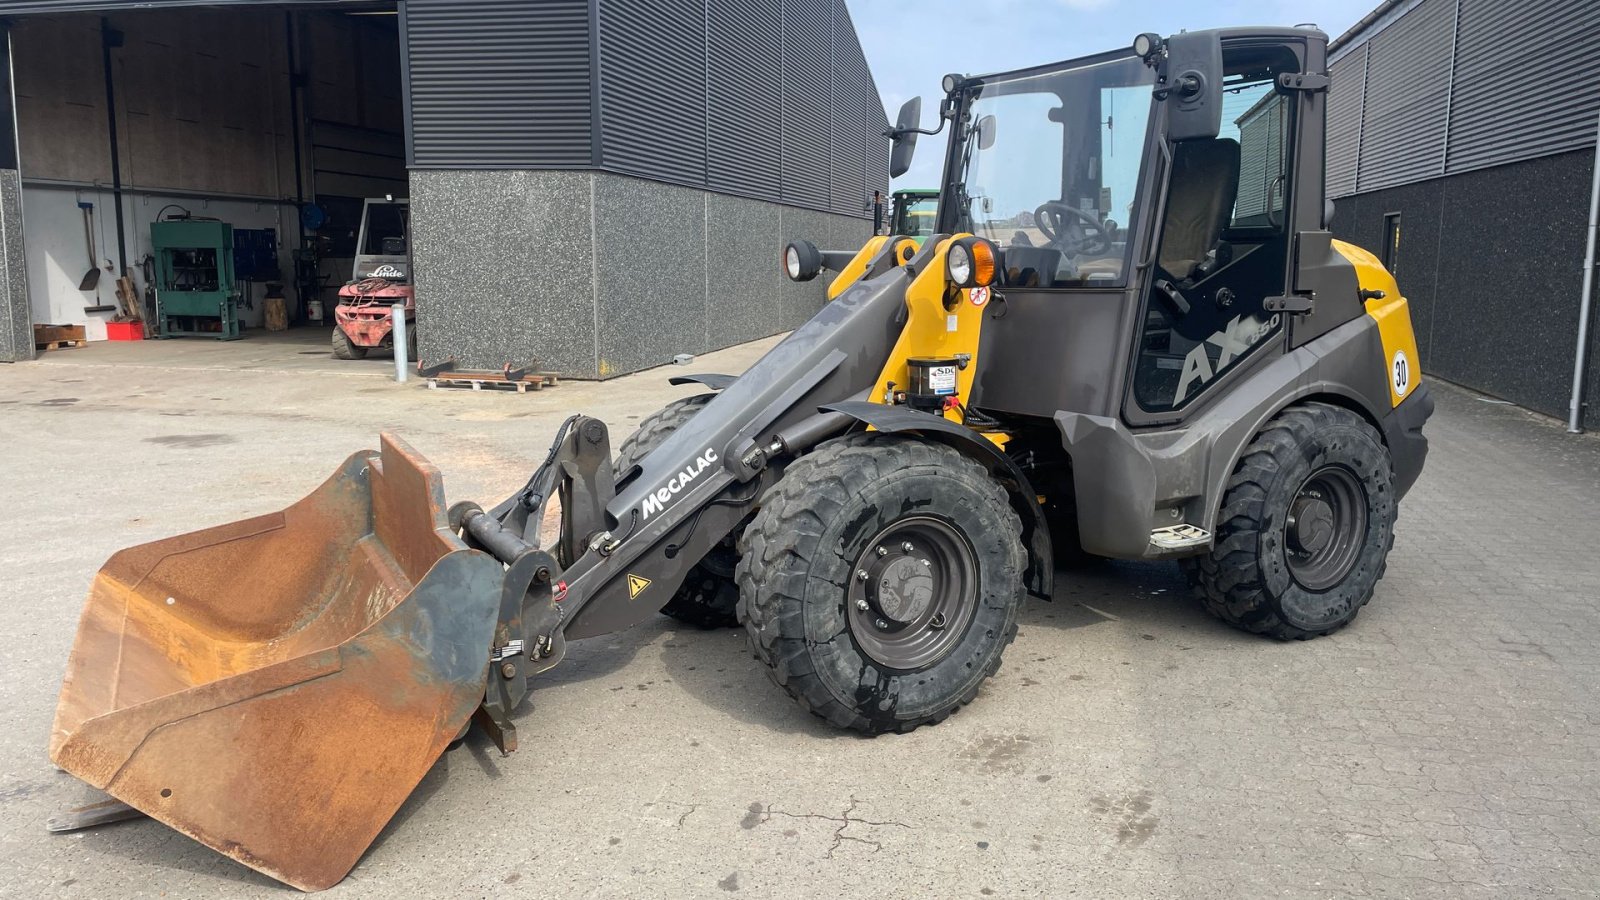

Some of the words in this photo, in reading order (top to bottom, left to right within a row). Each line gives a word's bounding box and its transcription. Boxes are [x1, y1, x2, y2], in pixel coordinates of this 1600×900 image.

[366, 264, 405, 278] Linde
[1172, 313, 1250, 408] AX
[1395, 359, 1407, 387] 30
